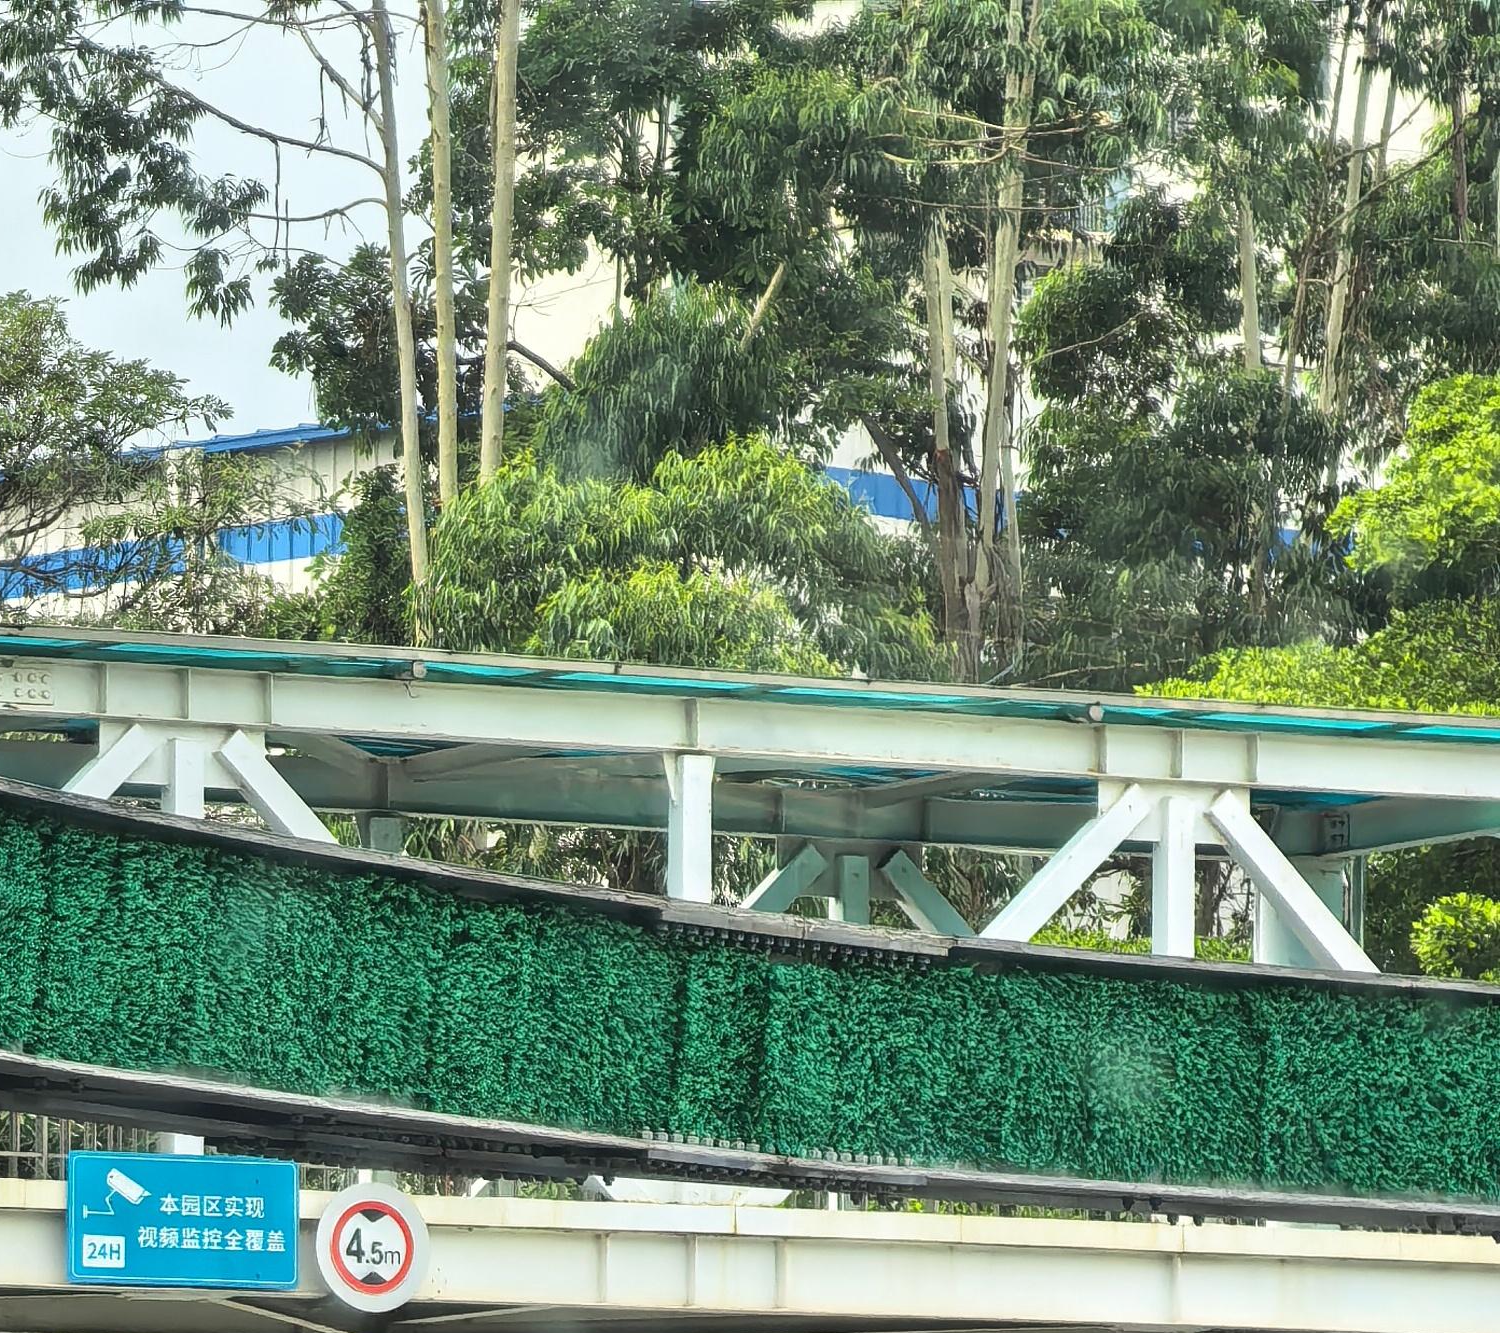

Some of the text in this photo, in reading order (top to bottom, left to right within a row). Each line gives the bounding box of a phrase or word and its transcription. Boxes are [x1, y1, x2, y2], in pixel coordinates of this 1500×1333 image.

[159, 1193, 266, 1219] 本园区实现
[87, 1242, 122, 1261] 24H
[137, 1226, 286, 1252] 视频监控全覆盖
[345, 1227, 401, 1265] 4.5m
